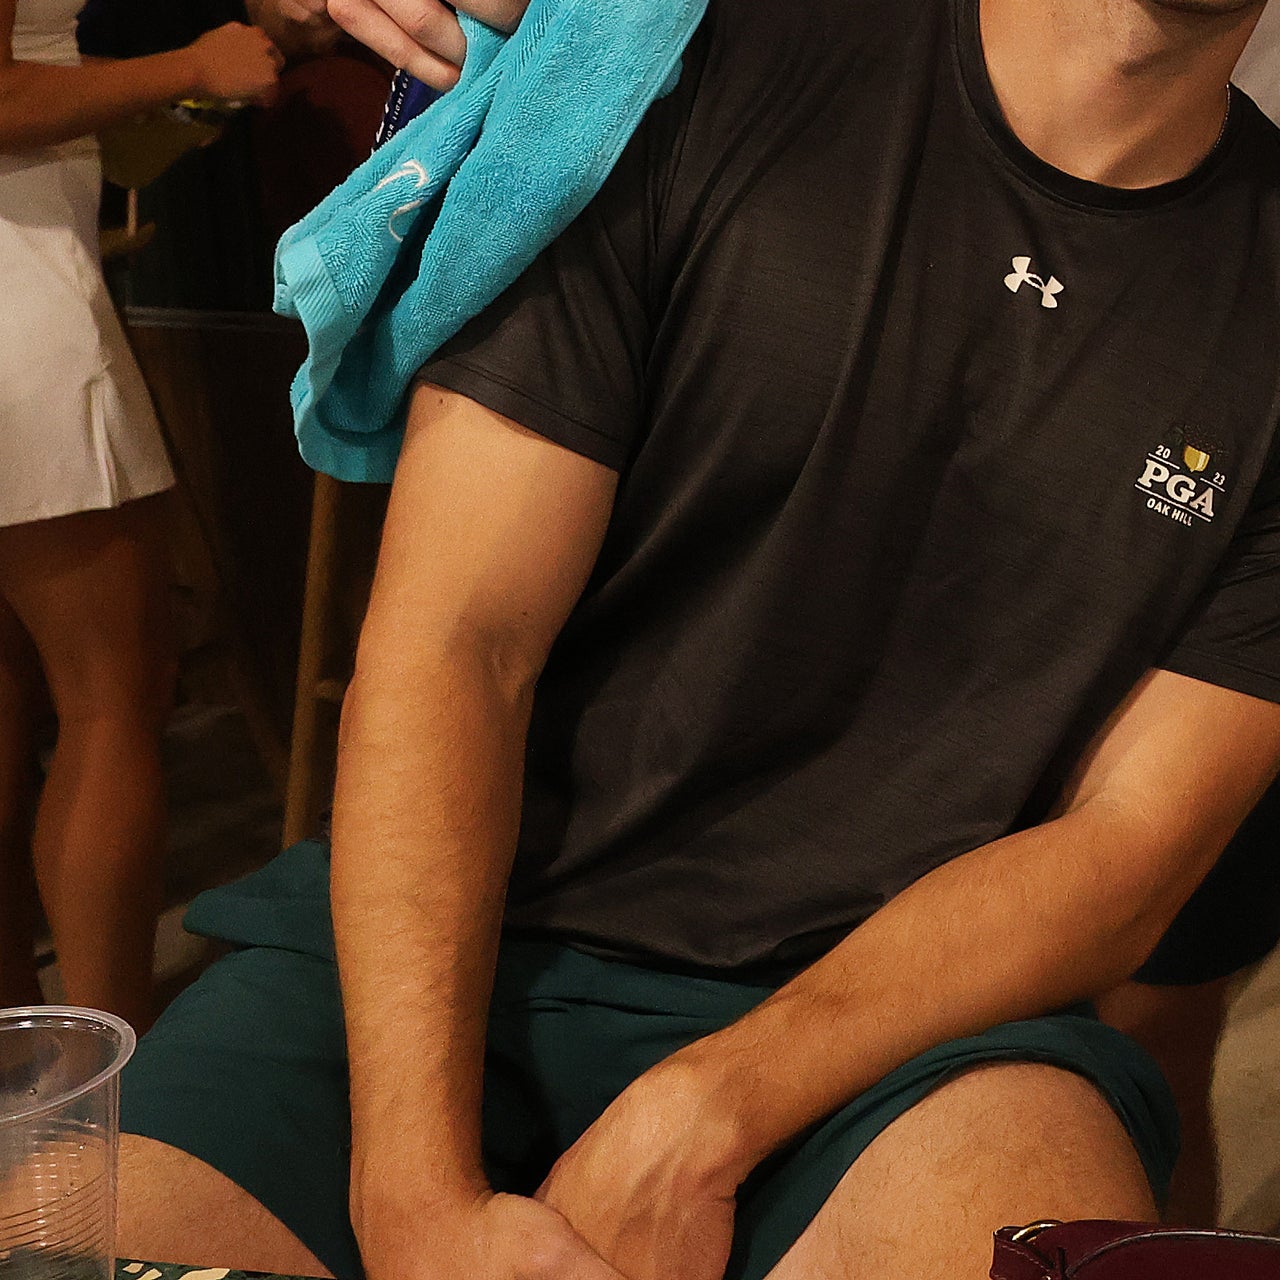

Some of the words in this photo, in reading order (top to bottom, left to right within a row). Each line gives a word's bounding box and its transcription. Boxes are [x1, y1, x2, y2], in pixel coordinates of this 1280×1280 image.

[1155, 444, 1171, 459] 20
[1212, 472, 1226, 486] 23
[1137, 459, 1215, 517] PGA
[1146, 498, 1171, 516] OAK
[1171, 510, 1192, 527] HILL
